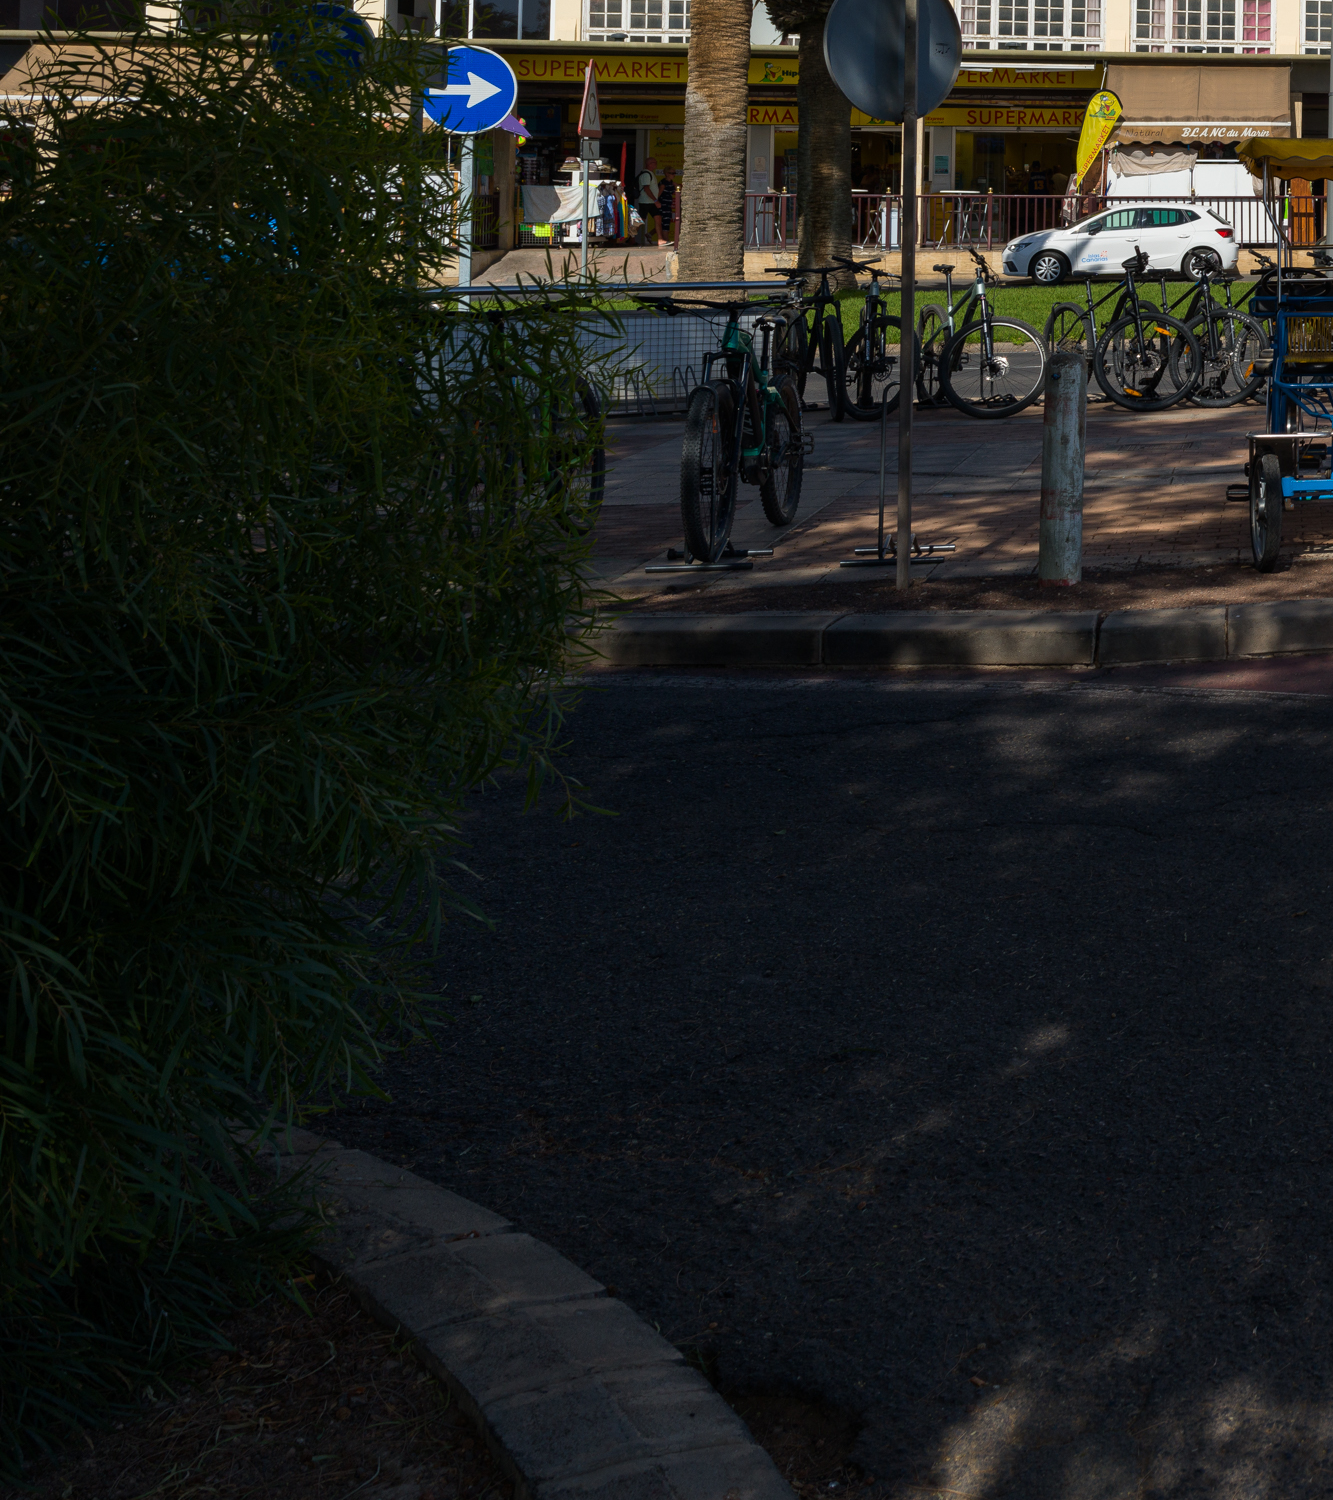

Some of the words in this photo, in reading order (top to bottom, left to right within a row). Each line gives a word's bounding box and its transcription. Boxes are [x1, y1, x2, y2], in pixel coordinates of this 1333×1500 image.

[517, 59, 685, 79] SUPERMARKET
[1124, 128, 1164, 138] Natural
[1227, 128, 1238, 137] du
[1240, 127, 1270, 137] Marin
[1077, 124, 1111, 179] SUPERMARKET
